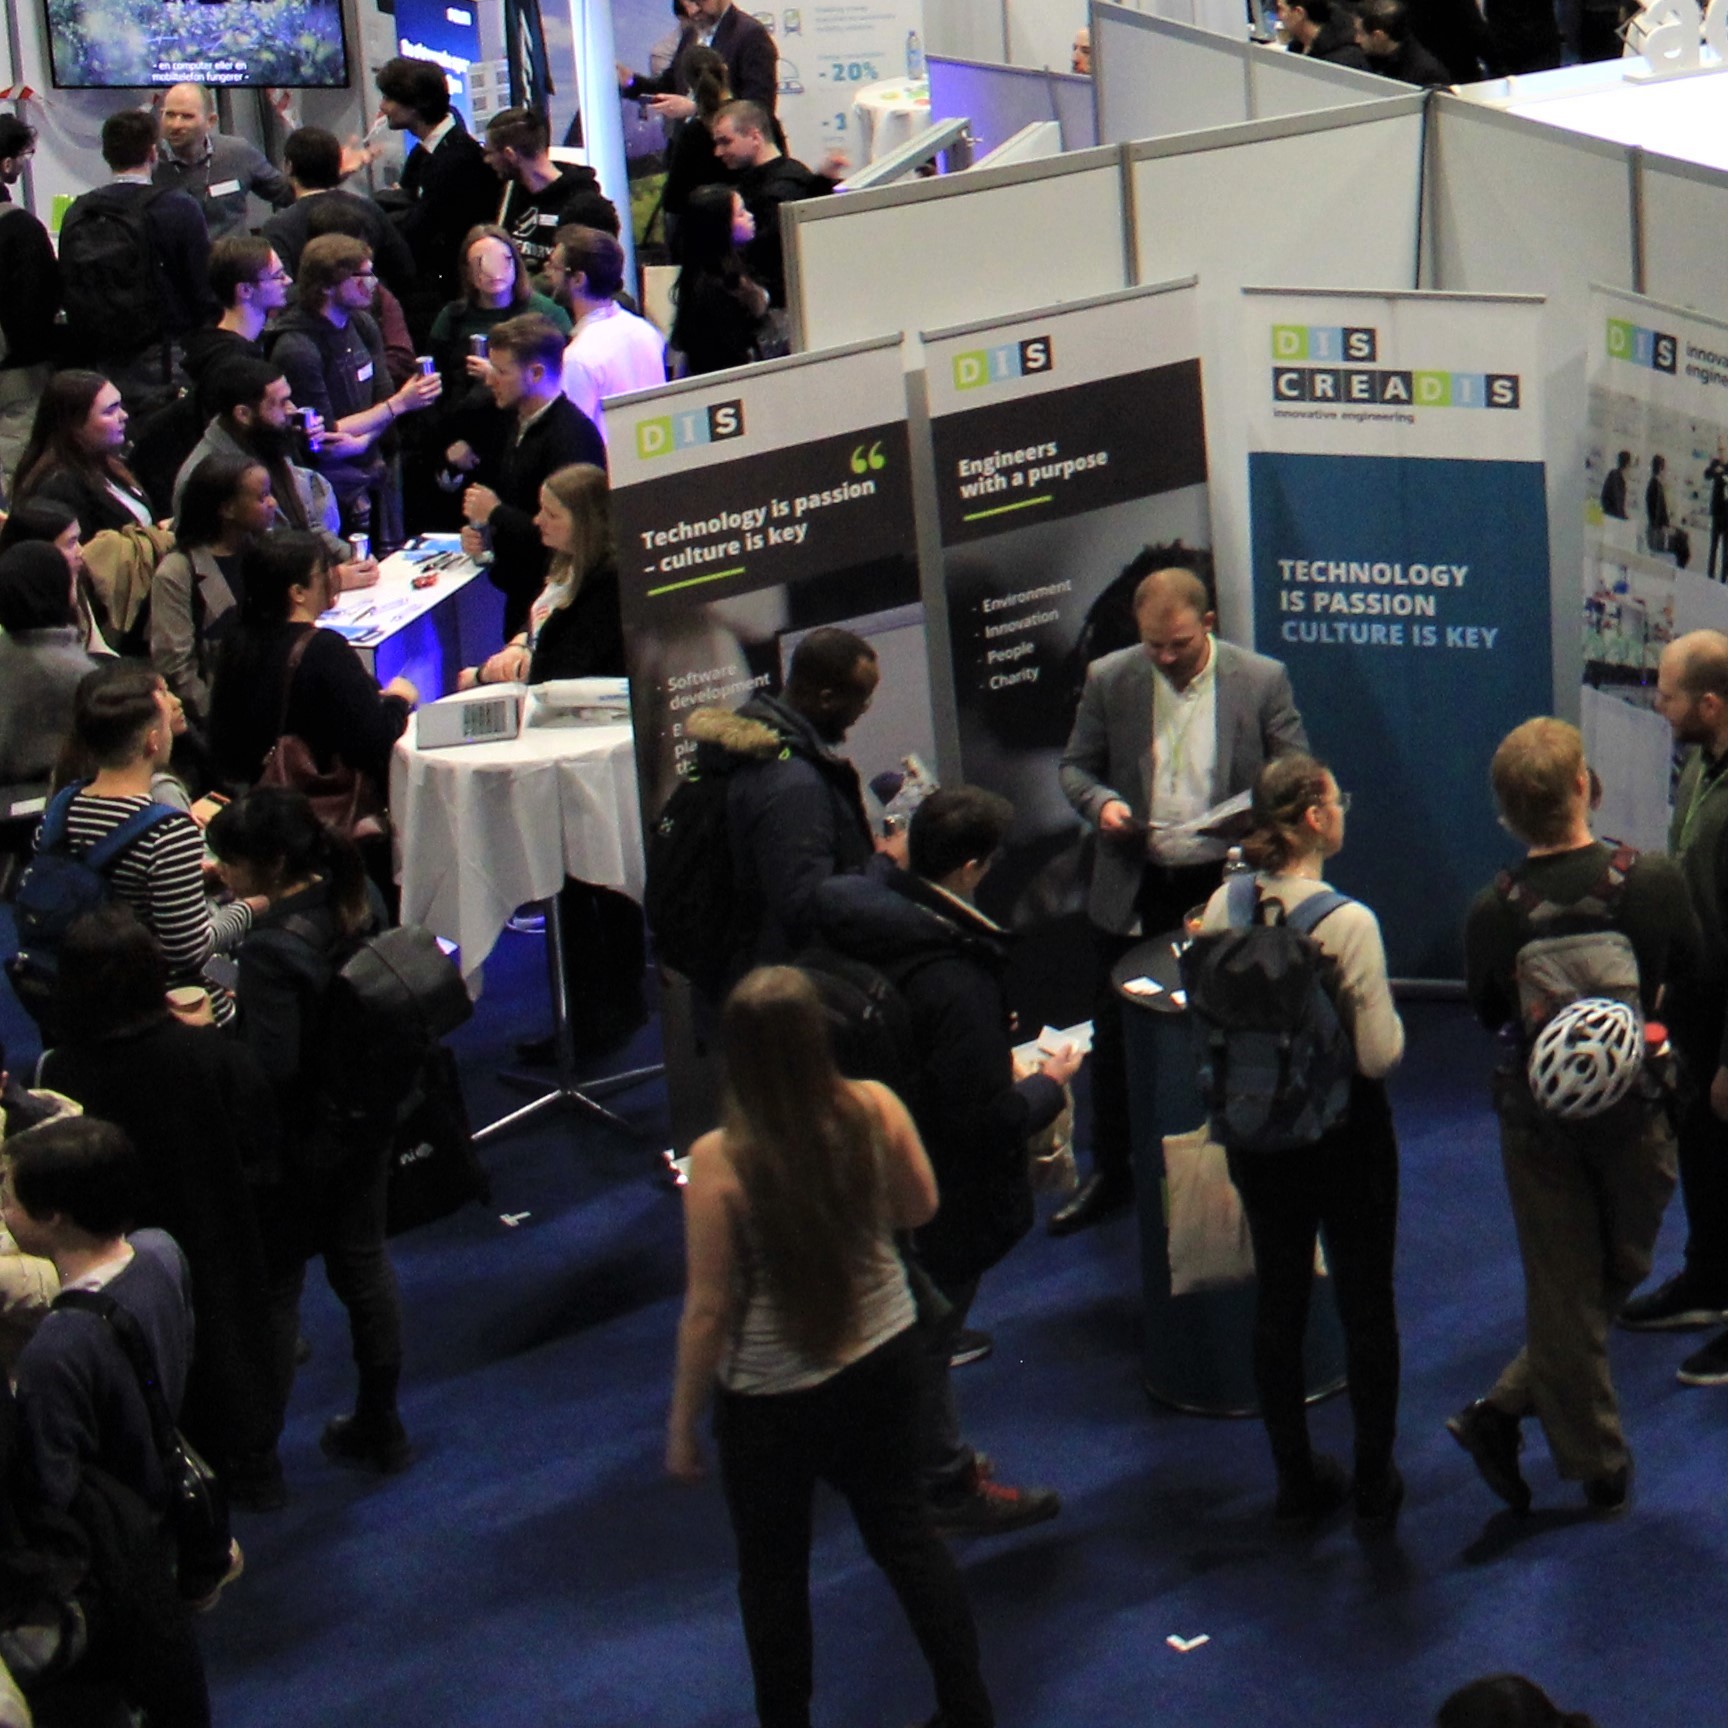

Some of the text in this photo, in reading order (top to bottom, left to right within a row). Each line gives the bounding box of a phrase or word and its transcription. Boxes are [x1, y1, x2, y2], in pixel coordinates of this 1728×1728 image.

[172, 61, 213, 72] computer
[1275, 330, 1370, 358] DIS
[1608, 325, 1673, 369] DIS
[958, 343, 1047, 384] DIS
[1276, 372, 1515, 404] CREADIS
[642, 406, 738, 453] DIS
[1273, 407, 1415, 423] innovative engineering
[958, 441, 1058, 477] Engineers
[960, 450, 1109, 499] with a purpose
[641, 480, 876, 551] Technology is passion
[660, 538, 740, 573] culture
[745, 532, 764, 552] is
[768, 522, 809, 547] key
[1278, 558, 1468, 587] TECHNOLOGY
[983, 579, 1072, 613] Environment
[1280, 589, 1436, 616] IS PASSION
[985, 609, 1059, 639] Innovation
[1281, 620, 1498, 649] CULTURE IS KEY
[987, 641, 1035, 665] People
[667, 664, 737, 692] Software
[670, 673, 770, 710] development
[990, 666, 1039, 690] Charity
